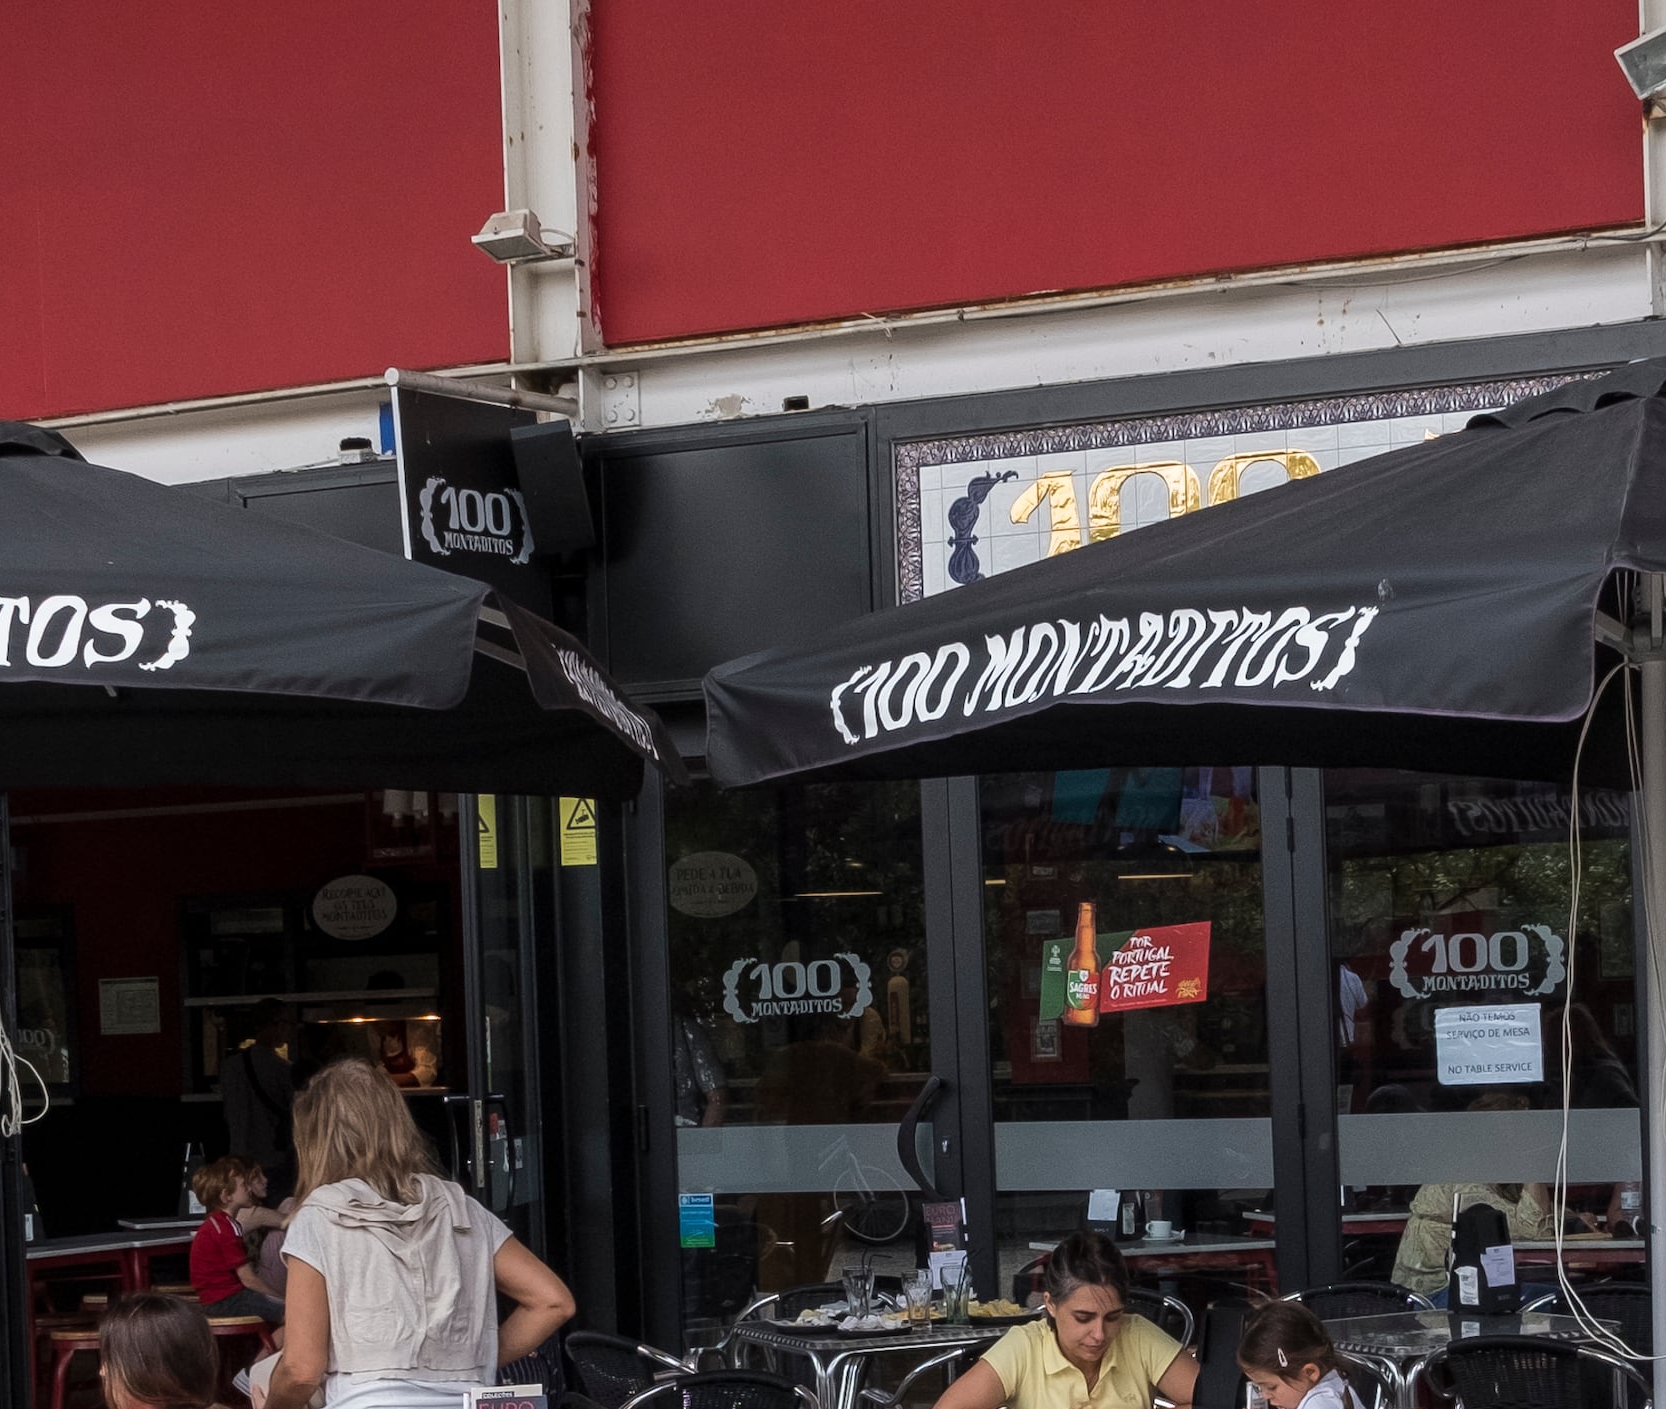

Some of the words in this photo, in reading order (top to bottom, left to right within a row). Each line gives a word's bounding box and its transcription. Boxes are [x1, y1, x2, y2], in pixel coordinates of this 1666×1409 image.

[440, 486, 511, 536] 100
[443, 531, 514, 556] MONTADITOS
[853, 642, 971, 738] 100
[962, 605, 1357, 717] MONTADITOS
[1129, 935, 1153, 948] POR
[1111, 946, 1175, 965] PORTUGAL
[1421, 931, 1529, 973] 100
[749, 959, 841, 1000] 100
[1108, 961, 1171, 986] REPETE
[1422, 972, 1531, 991] MONTADITOS
[1069, 980, 1098, 994] SAGRES
[1110, 988, 1120, 1000] O
[1122, 980, 1169, 998] RITUAL
[750, 998, 843, 1017] MONTADITOS
[1458, 1010, 1480, 1023] NÃO
[1446, 1029, 1486, 1041] SERVIÇO
[1488, 1028, 1501, 1039] DE
[1503, 1027, 1531, 1038] MESA
[1448, 1064, 1463, 1075] NO
[1465, 1063, 1493, 1074] TABLE
[1494, 1061, 1533, 1073] SERVICE
